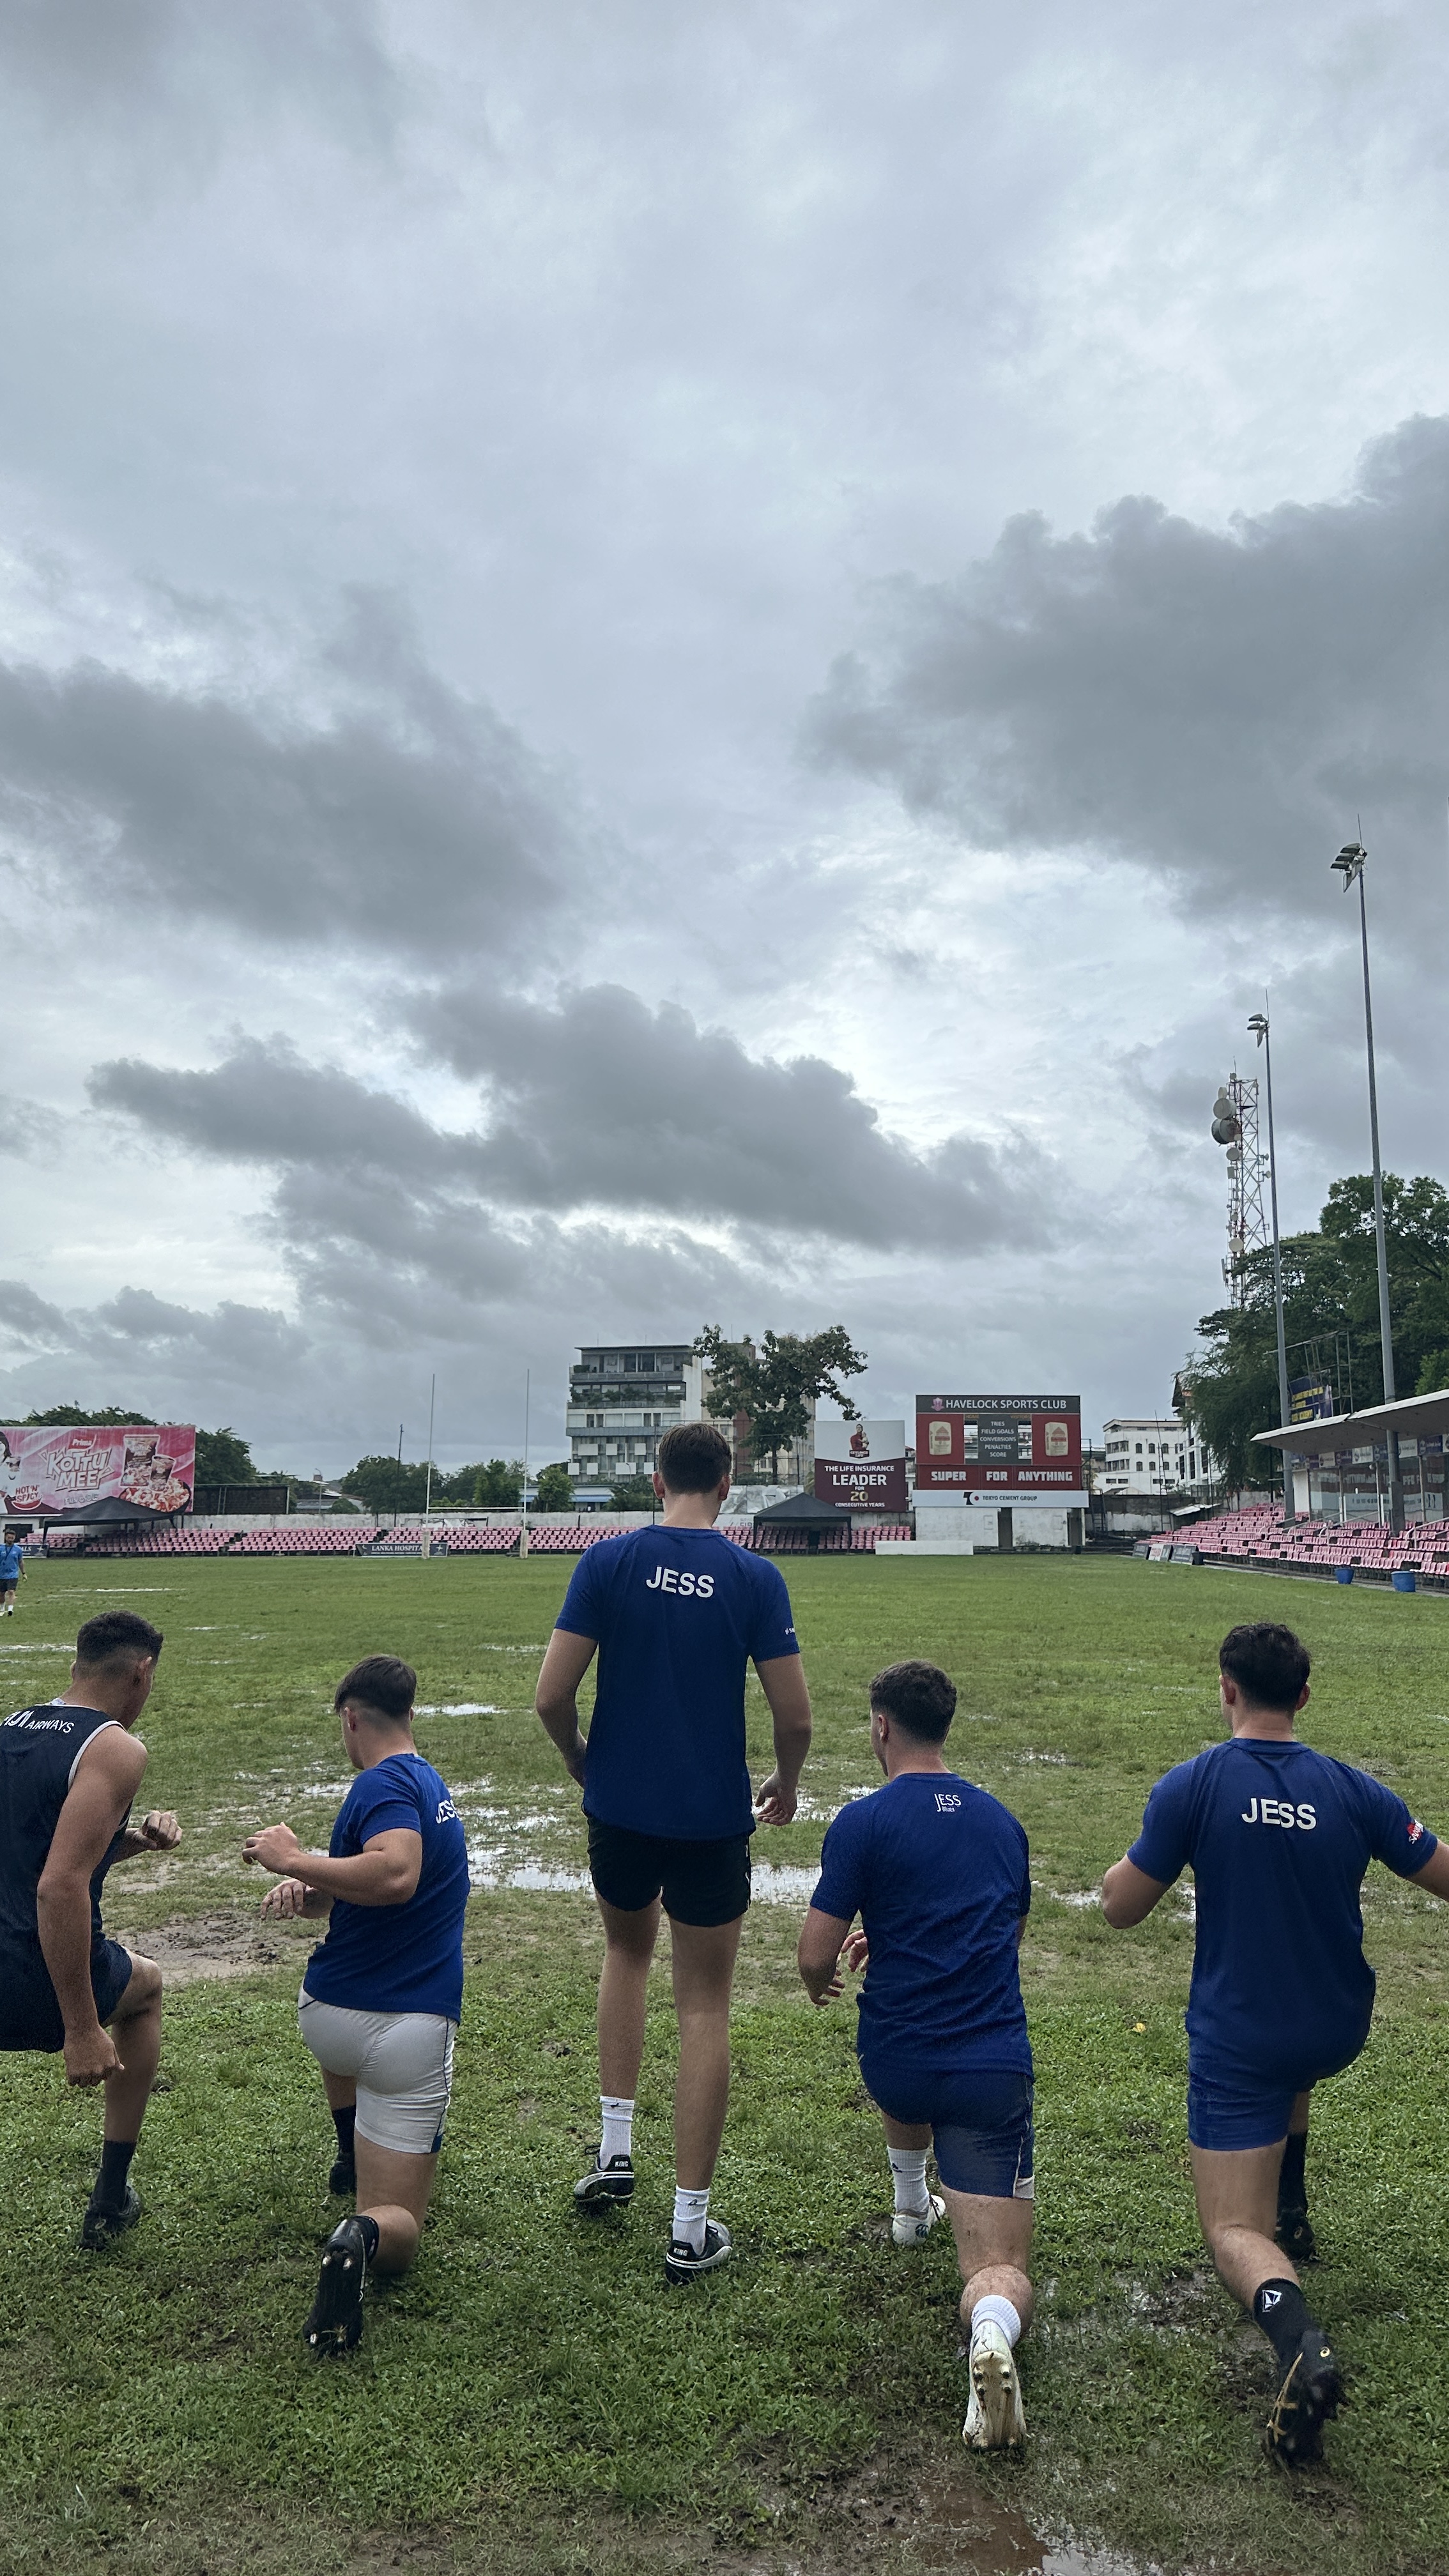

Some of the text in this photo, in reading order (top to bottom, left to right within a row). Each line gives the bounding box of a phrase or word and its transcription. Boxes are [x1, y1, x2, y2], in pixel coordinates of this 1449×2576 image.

[946, 1399, 1066, 1409] HAVELOCK SPORTS CLUB
[72, 1438, 93, 1446] Prima
[47, 1448, 111, 1476] KOTTU
[56, 1470, 100, 1489] MEE
[832, 1474, 887, 1485] LEADER
[931, 1471, 1073, 1482] SUPER FOR ANYTHING
[15, 1486, 29, 1495] HOT
[850, 1491, 869, 1501] 20
[15, 1492, 39, 1502] SPICY
[646, 1566, 714, 1598] JESS
[24, 1720, 75, 1733] AIRWAYS
[934, 1793, 962, 1812] JESS
[1241, 1798, 1316, 1830] JESS
